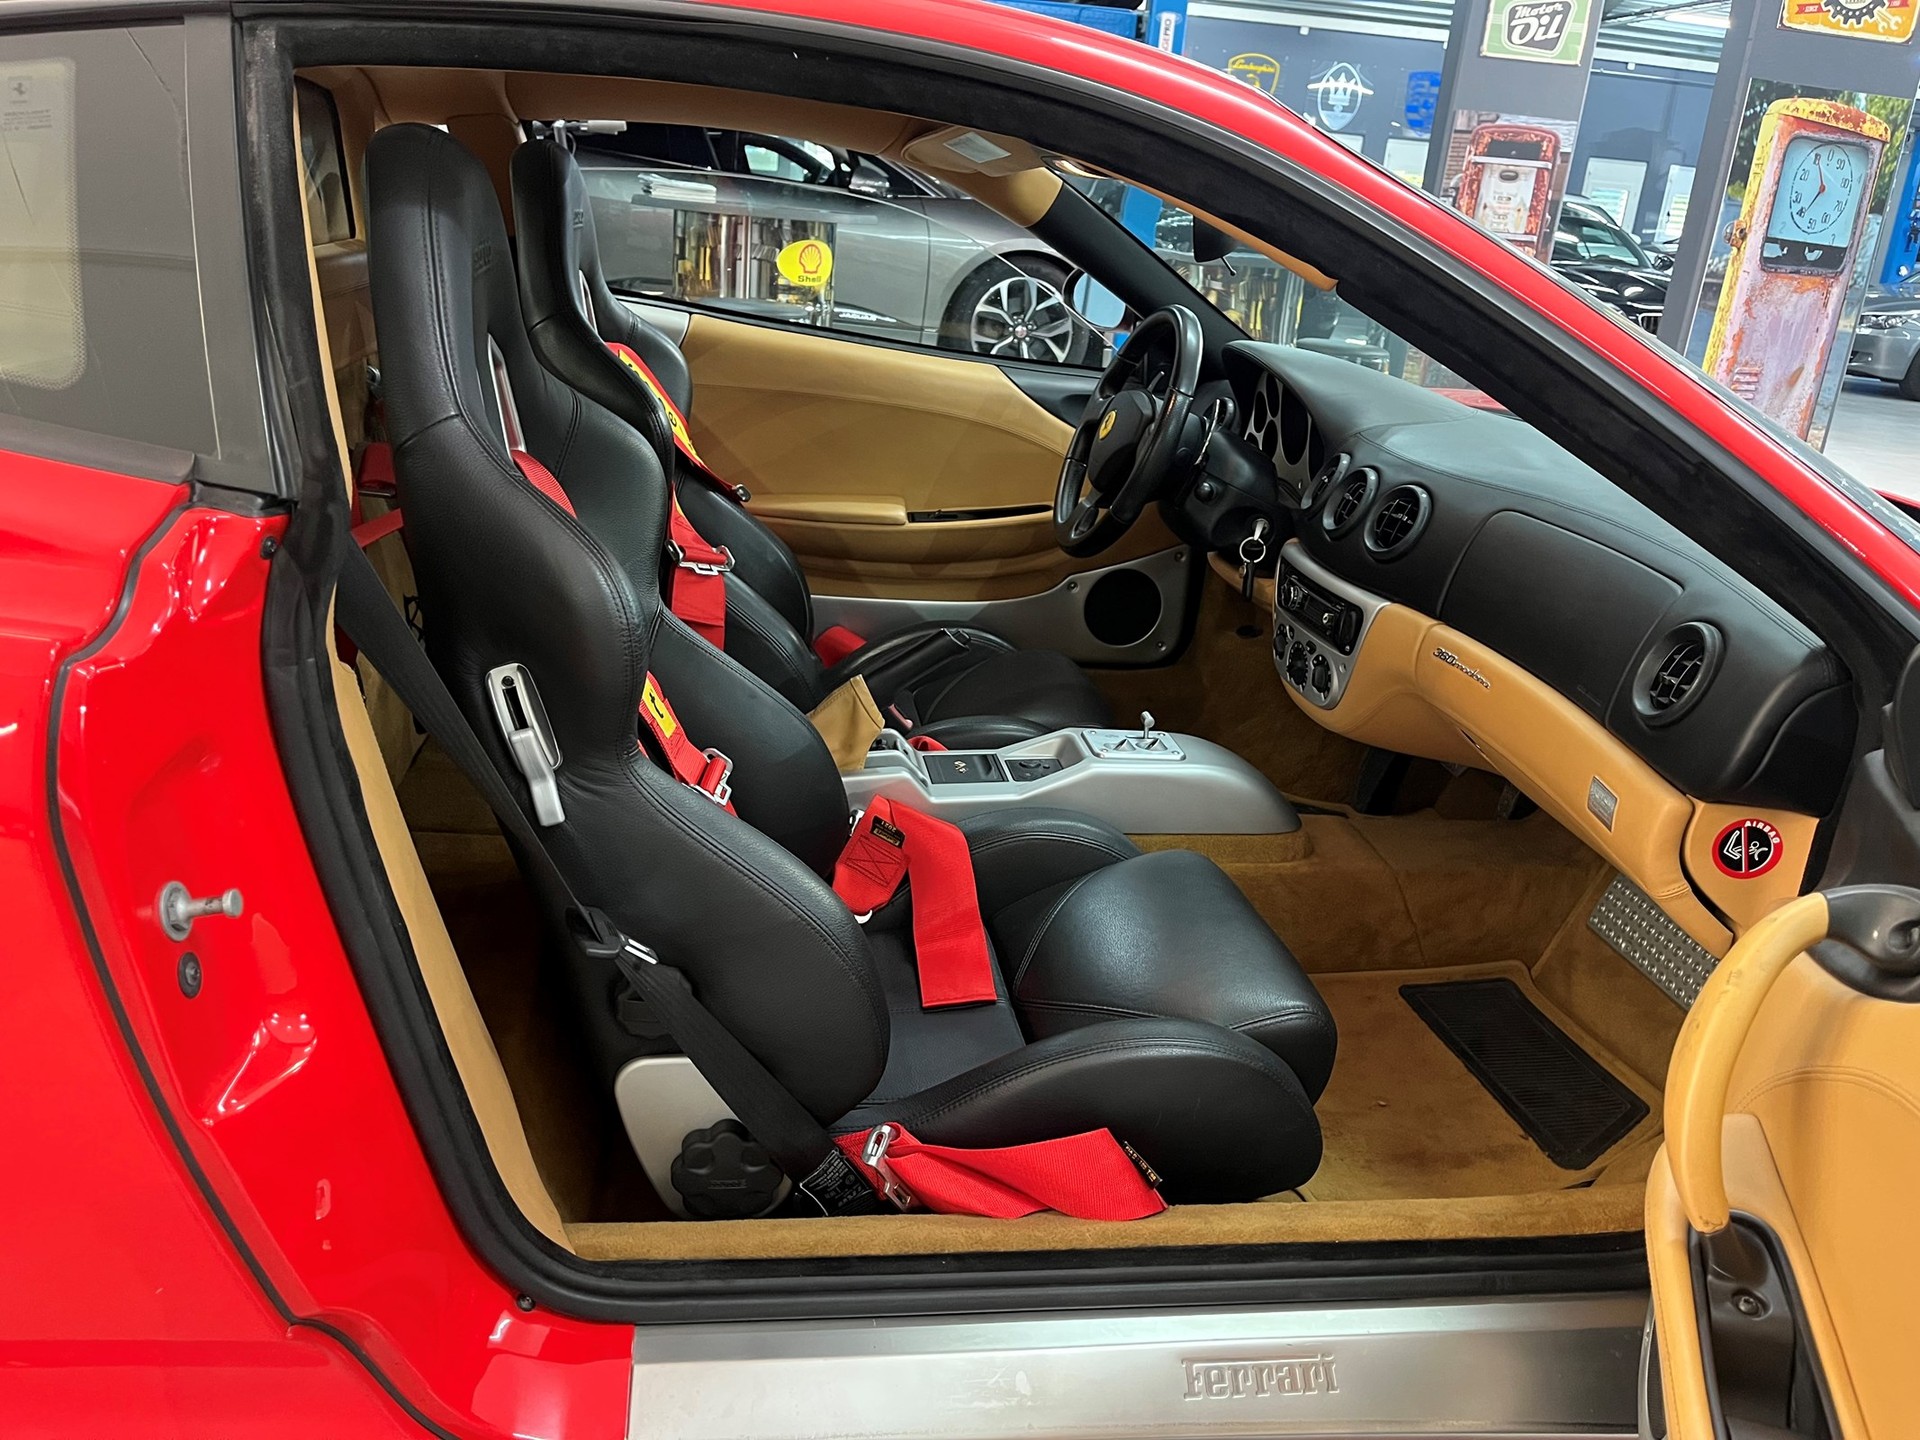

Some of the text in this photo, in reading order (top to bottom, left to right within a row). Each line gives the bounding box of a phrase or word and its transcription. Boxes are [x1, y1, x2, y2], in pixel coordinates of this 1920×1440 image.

[1514, 3, 1564, 18] Motor
[1510, 14, 1563, 45] Oil
[1836, 159, 1845, 170] 90
[1800, 169, 1810, 181] 20
[1834, 200, 1843, 213] 70
[1807, 218, 1817, 230] 50
[797, 275, 822, 283] Shell
[1744, 820, 1781, 844] AIRBAG
[1181, 1353, 1340, 1401] Ferrari
